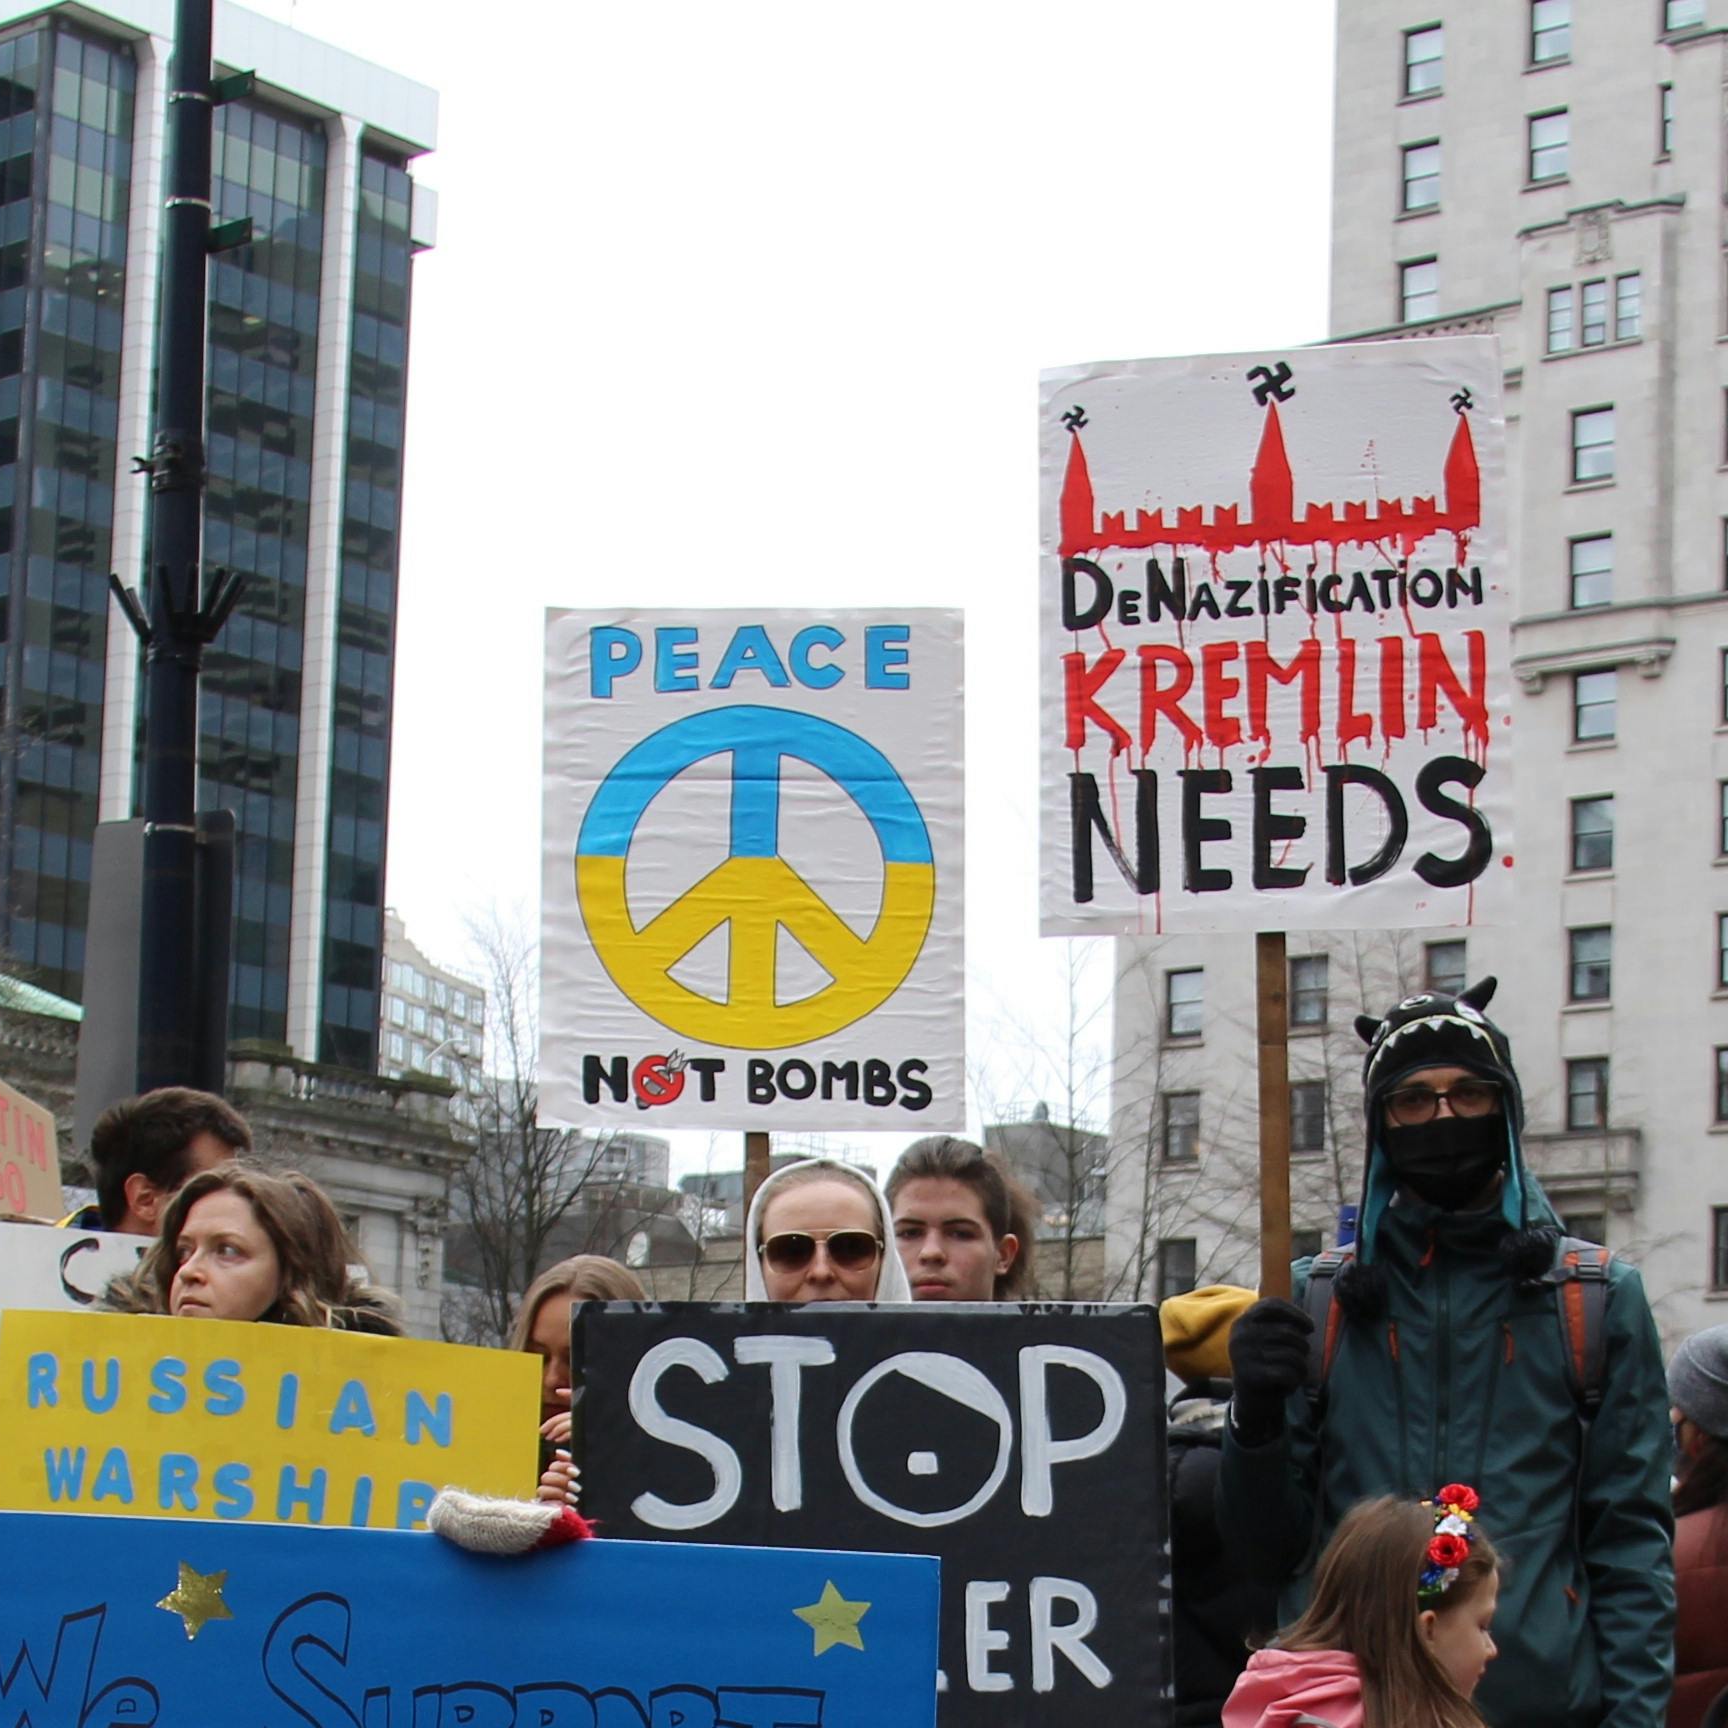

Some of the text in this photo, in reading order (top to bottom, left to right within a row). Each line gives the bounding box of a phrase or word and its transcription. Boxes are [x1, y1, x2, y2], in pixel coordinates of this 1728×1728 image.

[589, 624, 911, 698] PEACE
[1060, 631, 1489, 750] KREMLIN
[1067, 755, 1493, 903] NEEDS
[582, 1050, 933, 1112] NOT BOMBS
[27, 1352, 453, 1447] RUSSIAN
[628, 1335, 1127, 1530] STOP
[44, 1446, 435, 1530] WARSHIP
